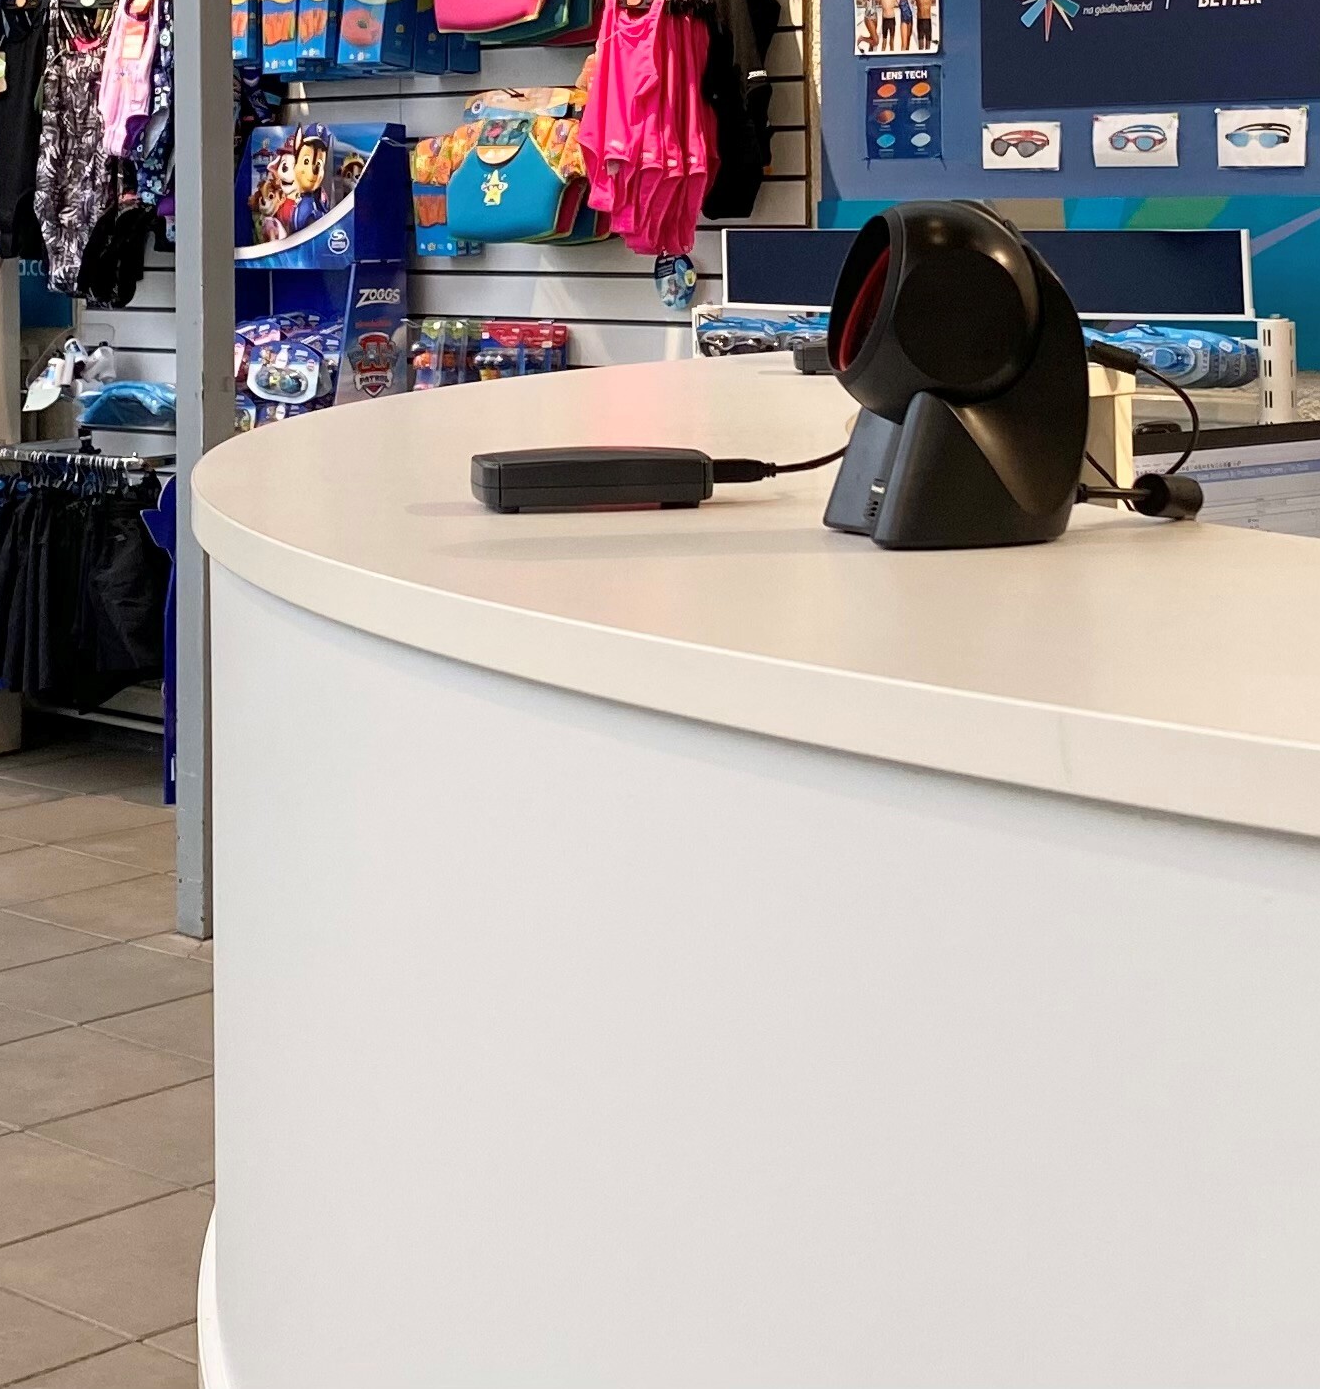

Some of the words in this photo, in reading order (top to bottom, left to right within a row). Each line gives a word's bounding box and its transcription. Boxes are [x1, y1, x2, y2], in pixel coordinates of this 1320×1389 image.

[881, 71, 903, 80] LENS
[904, 70, 928, 79] TECH
[355, 288, 401, 308] ZOGGS
